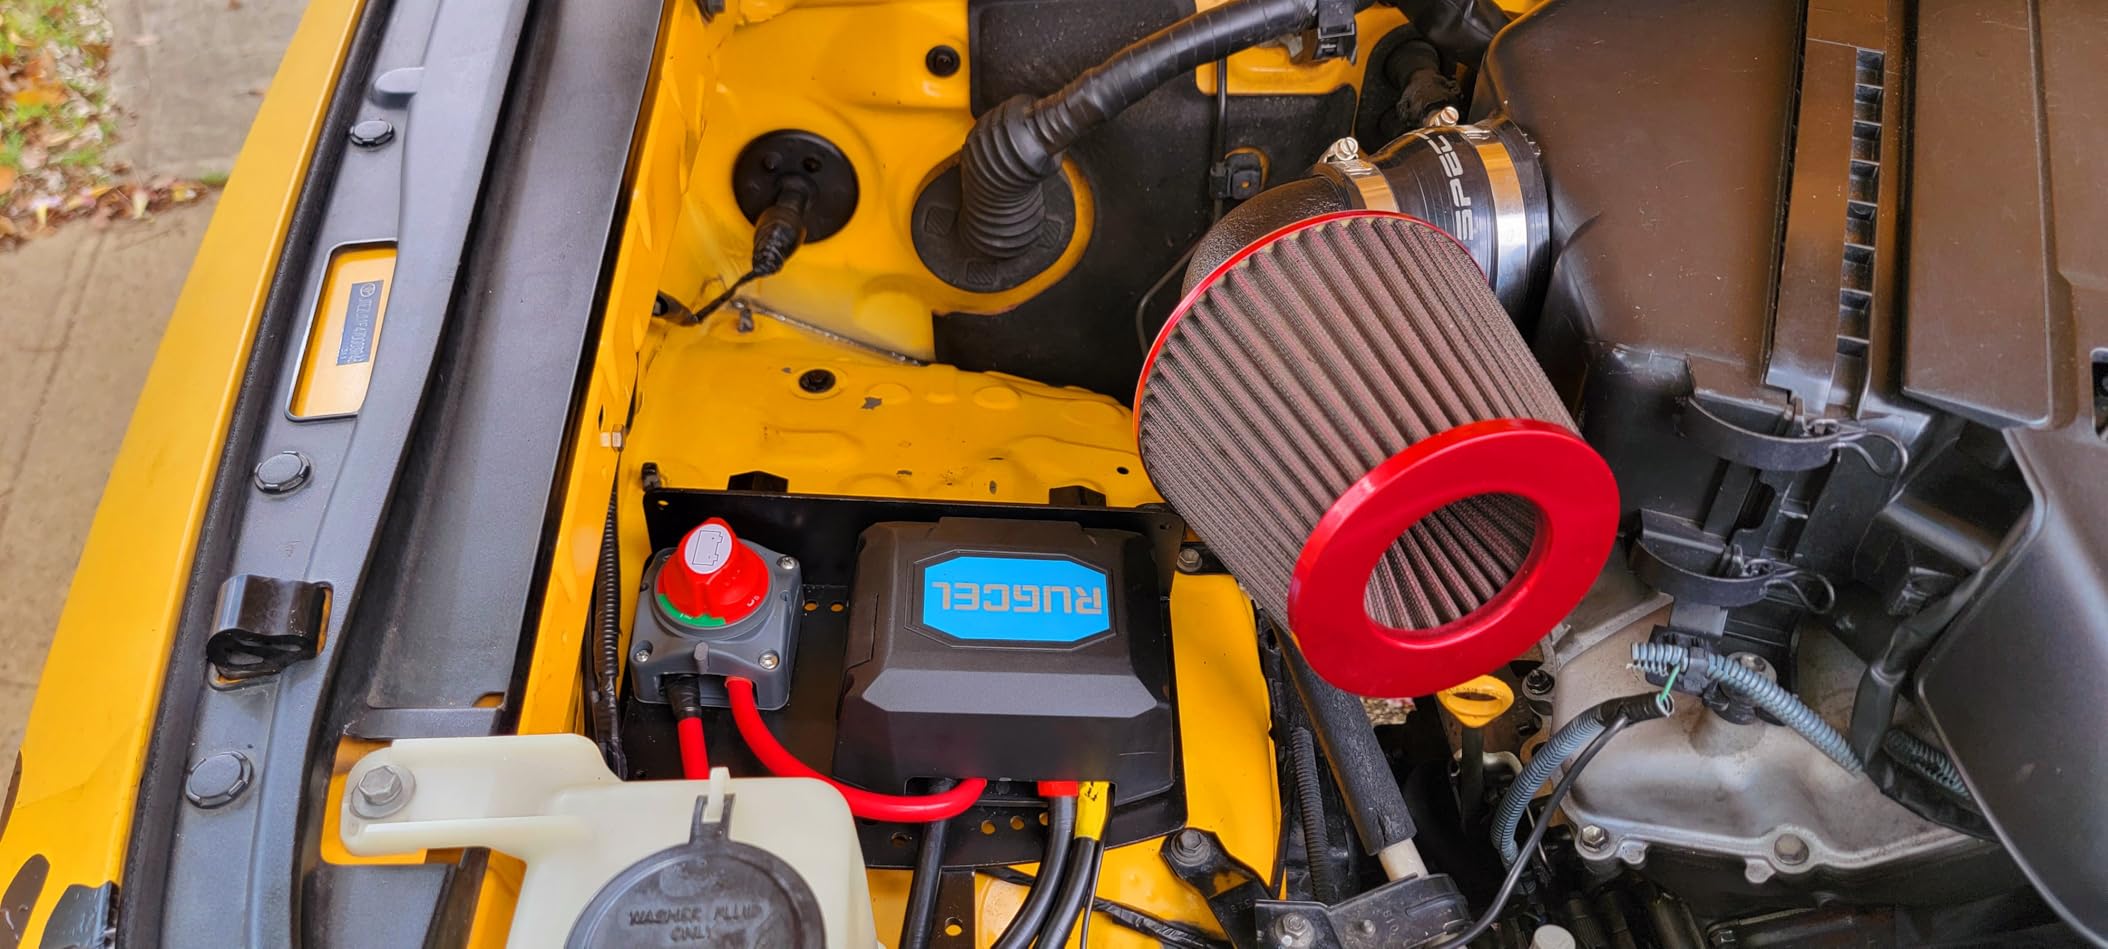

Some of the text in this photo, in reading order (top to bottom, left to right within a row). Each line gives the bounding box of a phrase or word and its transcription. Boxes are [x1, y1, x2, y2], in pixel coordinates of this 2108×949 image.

[931, 581, 1103, 615] RUGCEL
[629, 902, 763, 926] WASHER FLUID
[670, 926, 711, 942] ONLY
